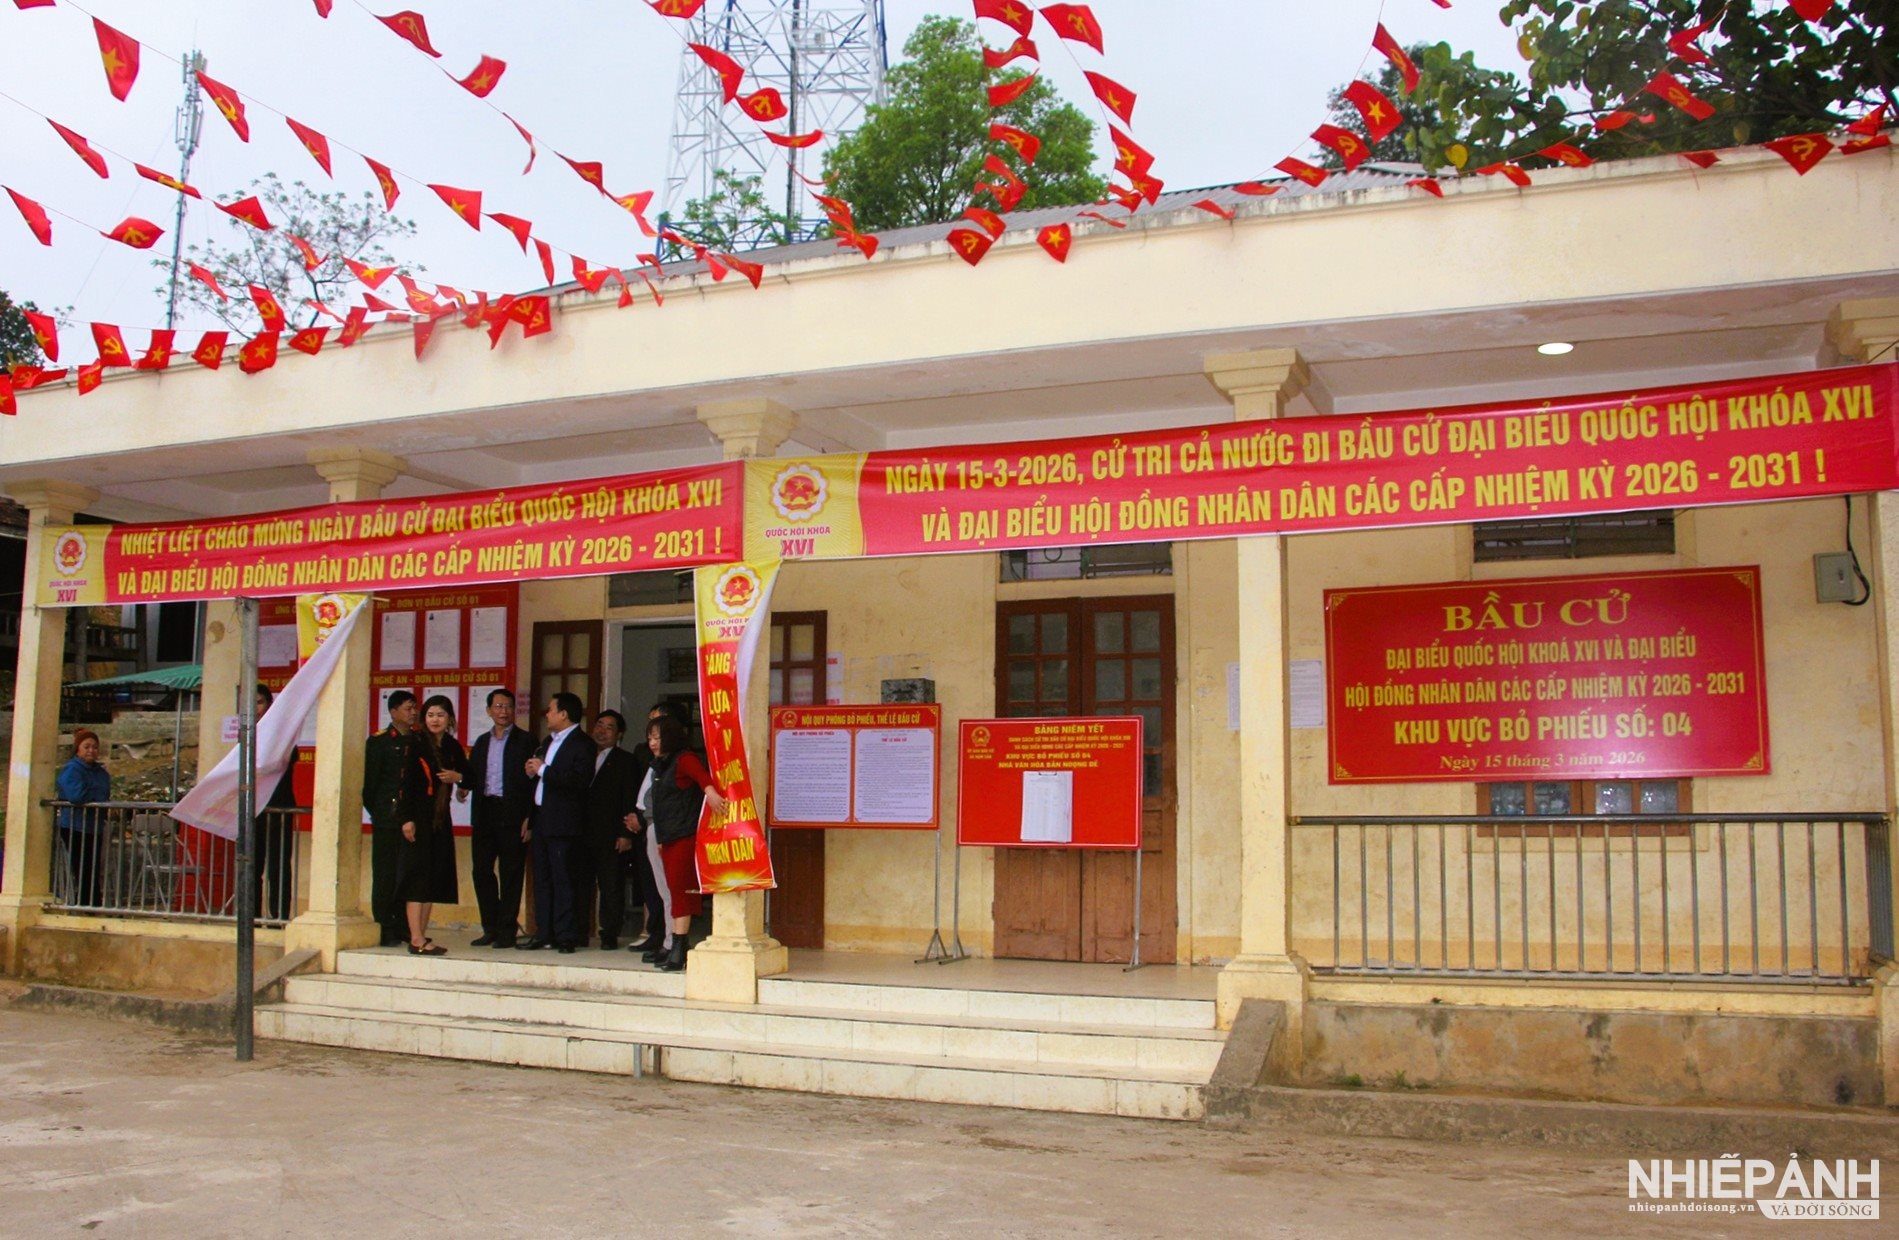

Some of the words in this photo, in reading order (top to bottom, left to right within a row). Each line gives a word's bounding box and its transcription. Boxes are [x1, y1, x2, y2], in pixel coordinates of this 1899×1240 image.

[886, 458, 947, 494] NGÀY
[956, 453, 1084, 487] 15-3-2026,
[1092, 438, 1127, 480] CỬ
[1132, 445, 1171, 476] TRI
[1180, 430, 1214, 473] CẢ
[1222, 428, 1294, 469] NƯỚC
[1302, 431, 1330, 463] ĐI
[1338, 416, 1393, 461] BẦU
[1403, 412, 1442, 456] CỬ
[1448, 419, 1496, 459] ĐẠI
[1504, 400, 1570, 449] BIỂU
[1581, 396, 1659, 446] QUỐC
[1668, 394, 1718, 441] HỘI
[1729, 387, 1813, 430] KHÓA
[1821, 385, 1875, 422] XVI
[921, 506, 951, 542] VÀ
[958, 509, 999, 546] ĐẠI
[1006, 495, 1062, 538] BIỂU
[1069, 497, 1111, 539] HỘI
[1118, 489, 1189, 531] ĐỒNG
[1197, 485, 1271, 525] NHÂN
[1280, 481, 1336, 520] DÂN
[1345, 476, 1400, 515] CÁC
[1409, 467, 1466, 512] CẤP
[1474, 464, 1569, 511] NHIỆM
[1579, 459, 1615, 500] KỲ
[1625, 460, 1698, 497] 2026
[1707, 472, 1720, 481] -
[1729, 451, 1802, 490] 2031
[1814, 448, 1827, 483] !
[120, 527, 168, 558] NHIỆT
[168, 525, 202, 557] LIỆT
[205, 521, 249, 548] CHÀO
[253, 518, 303, 547] MỪNG
[308, 511, 355, 543] NGÀY
[359, 504, 398, 539] BẦU
[402, 501, 431, 536] CỬ
[432, 506, 466, 538] ĐẠI
[470, 491, 516, 530] BIỂU
[521, 487, 576, 527] QUỐC
[581, 486, 616, 523] HỘI
[622, 479, 681, 515] KHÓA
[687, 478, 722, 508] XVI
[118, 567, 137, 595] VÀ
[140, 570, 167, 599] ĐẠI
[170, 558, 207, 593] BIỂU
[211, 561, 238, 595] HỘI
[242, 555, 288, 589] ĐỒNG
[292, 554, 343, 586] NHÂN
[347, 552, 385, 582] DÂN
[389, 547, 428, 579] CÁC
[432, 540, 473, 577] CẤP
[477, 539, 543, 576] NHIỆM
[548, 534, 575, 568] KỲ
[580, 535, 633, 565] 2026
[653, 528, 704, 559] 2031
[714, 526, 722, 555] !
[781, 538, 815, 556] XVI
[57, 589, 77, 602] XVI
[1443, 590, 1545, 632] BẦU
[1559, 588, 1632, 627] CỬ
[720, 625, 746, 637] XV
[705, 648, 731, 676] ÁNG
[1386, 648, 1411, 674] ĐẠI
[1415, 638, 1449, 669] BIỂU
[1454, 637, 1494, 669] QUỐC
[1498, 639, 1523, 669] HỘI
[1528, 636, 1571, 665] KHOÁ
[1574, 640, 1599, 662] XVI
[1603, 634, 1624, 660] VÀ
[1627, 637, 1655, 664] ĐẠI
[1659, 626, 1697, 659] BIỂU
[708, 689, 731, 719] LỰA
[1345, 682, 1369, 712] HỘI
[1374, 678, 1414, 707] ĐỒNG
[1418, 678, 1461, 705] NHÂN
[1465, 677, 1497, 703] DÂN
[1501, 676, 1532, 702] CÁC
[1536, 670, 1568, 701] CẤP
[1571, 671, 1624, 703] NHIỆM
[1627, 670, 1649, 698] KỲ
[1652, 673, 1693, 697] 2026
[1706, 671, 1746, 695] 2031
[1034, 724, 1060, 735] BẢNG
[1088, 722, 1105, 733] YẾT
[1394, 720, 1440, 745] KHU
[1446, 715, 1492, 748] VỰC
[1499, 709, 1531, 742] BỎ
[1537, 706, 1607, 741] PHIẾU
[1615, 704, 1655, 739] SỐ:
[1661, 711, 1693, 737] 04
[1439, 755, 1479, 771] Ngày
[1484, 755, 1502, 768] 15
[1506, 752, 1551, 771] tháng
[1555, 753, 1565, 767] 3
[1569, 752, 1604, 766] năm
[1608, 750, 1646, 765] 2026
[731, 834, 756, 861] DÂN
